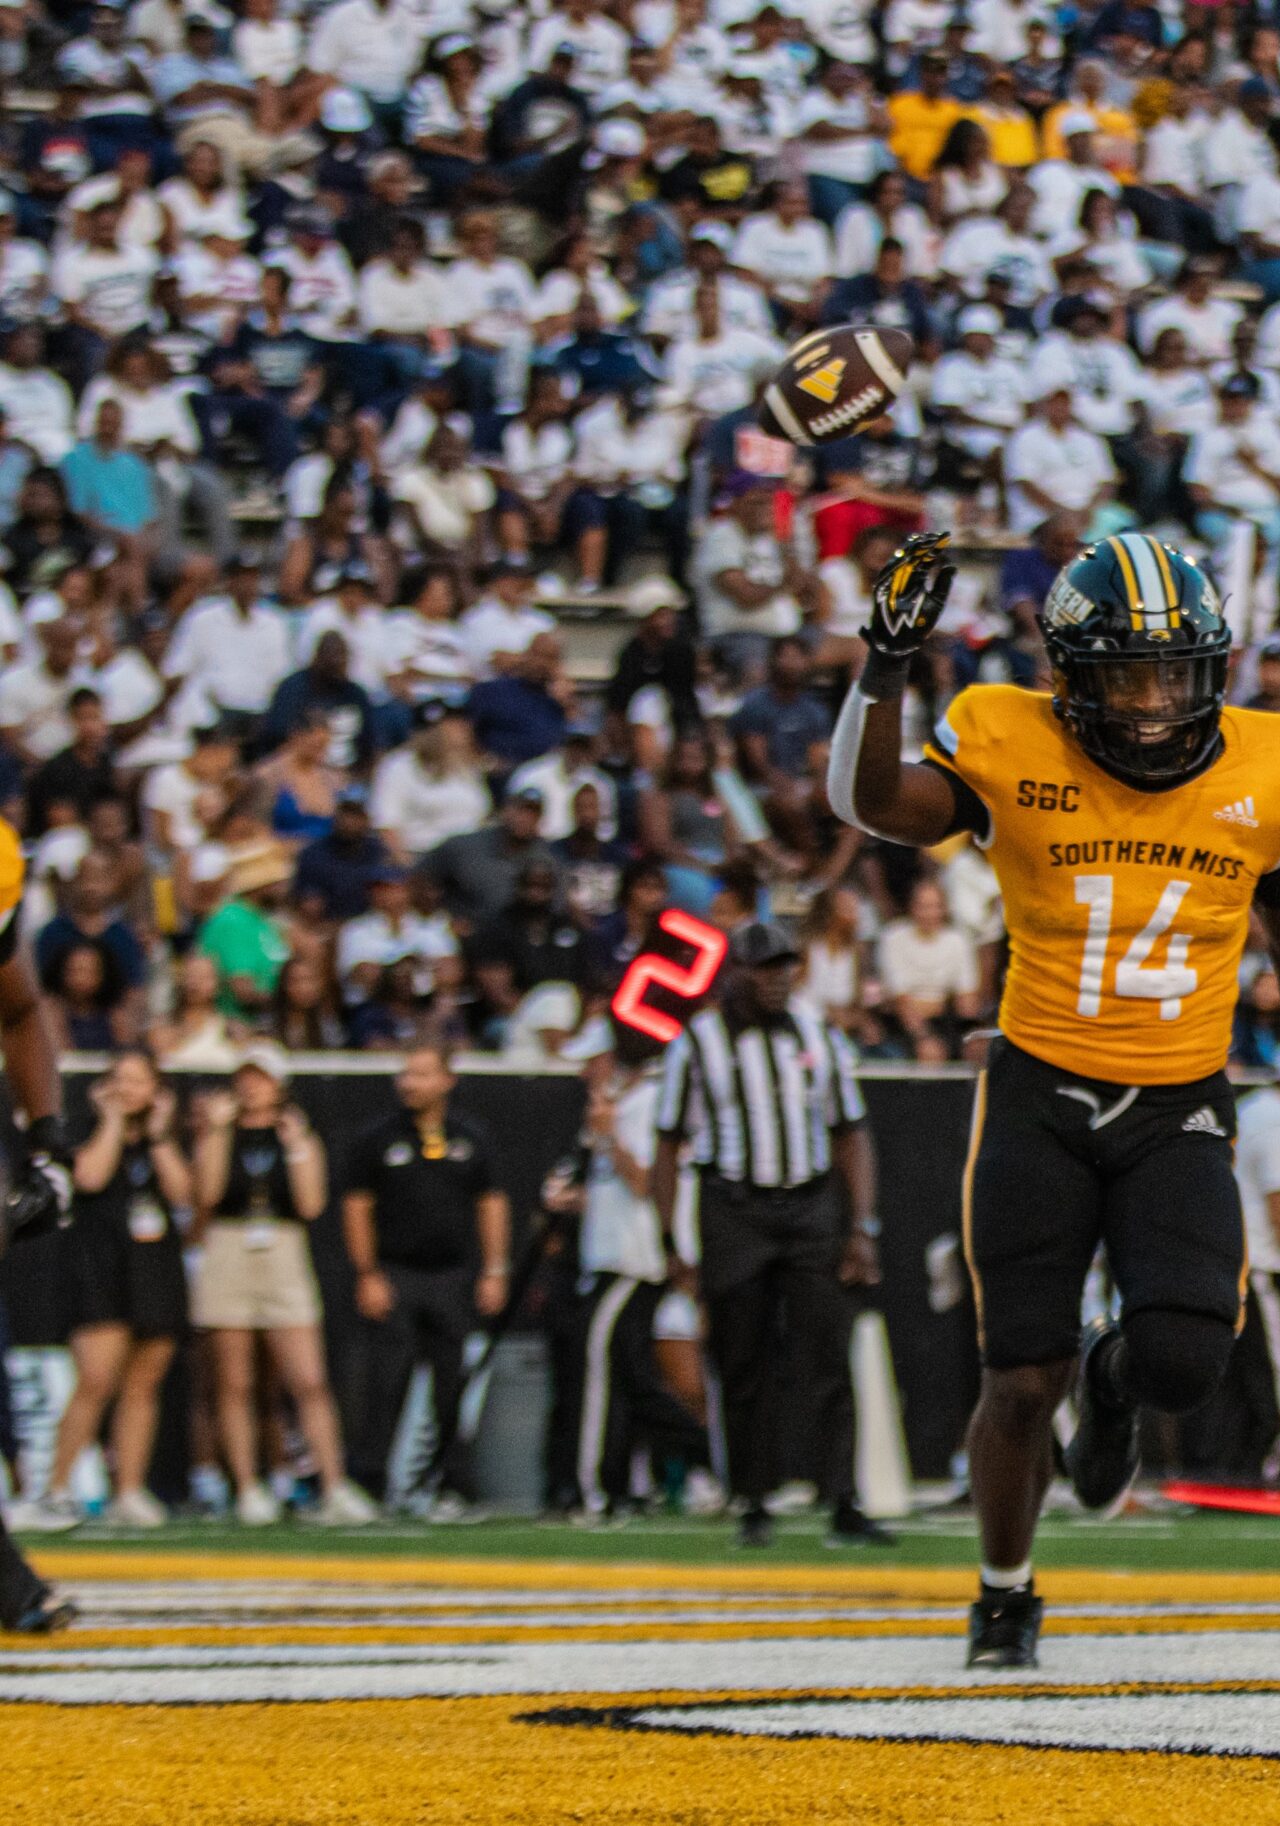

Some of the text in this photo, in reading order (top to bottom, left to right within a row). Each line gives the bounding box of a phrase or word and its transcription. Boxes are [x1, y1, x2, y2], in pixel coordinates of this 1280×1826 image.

[1016, 779, 1081, 813] SBC
[1049, 840, 1245, 880] SOUTHERN MISS
[611, 908, 729, 1043] 2
[1073, 874, 1198, 1021] 14
